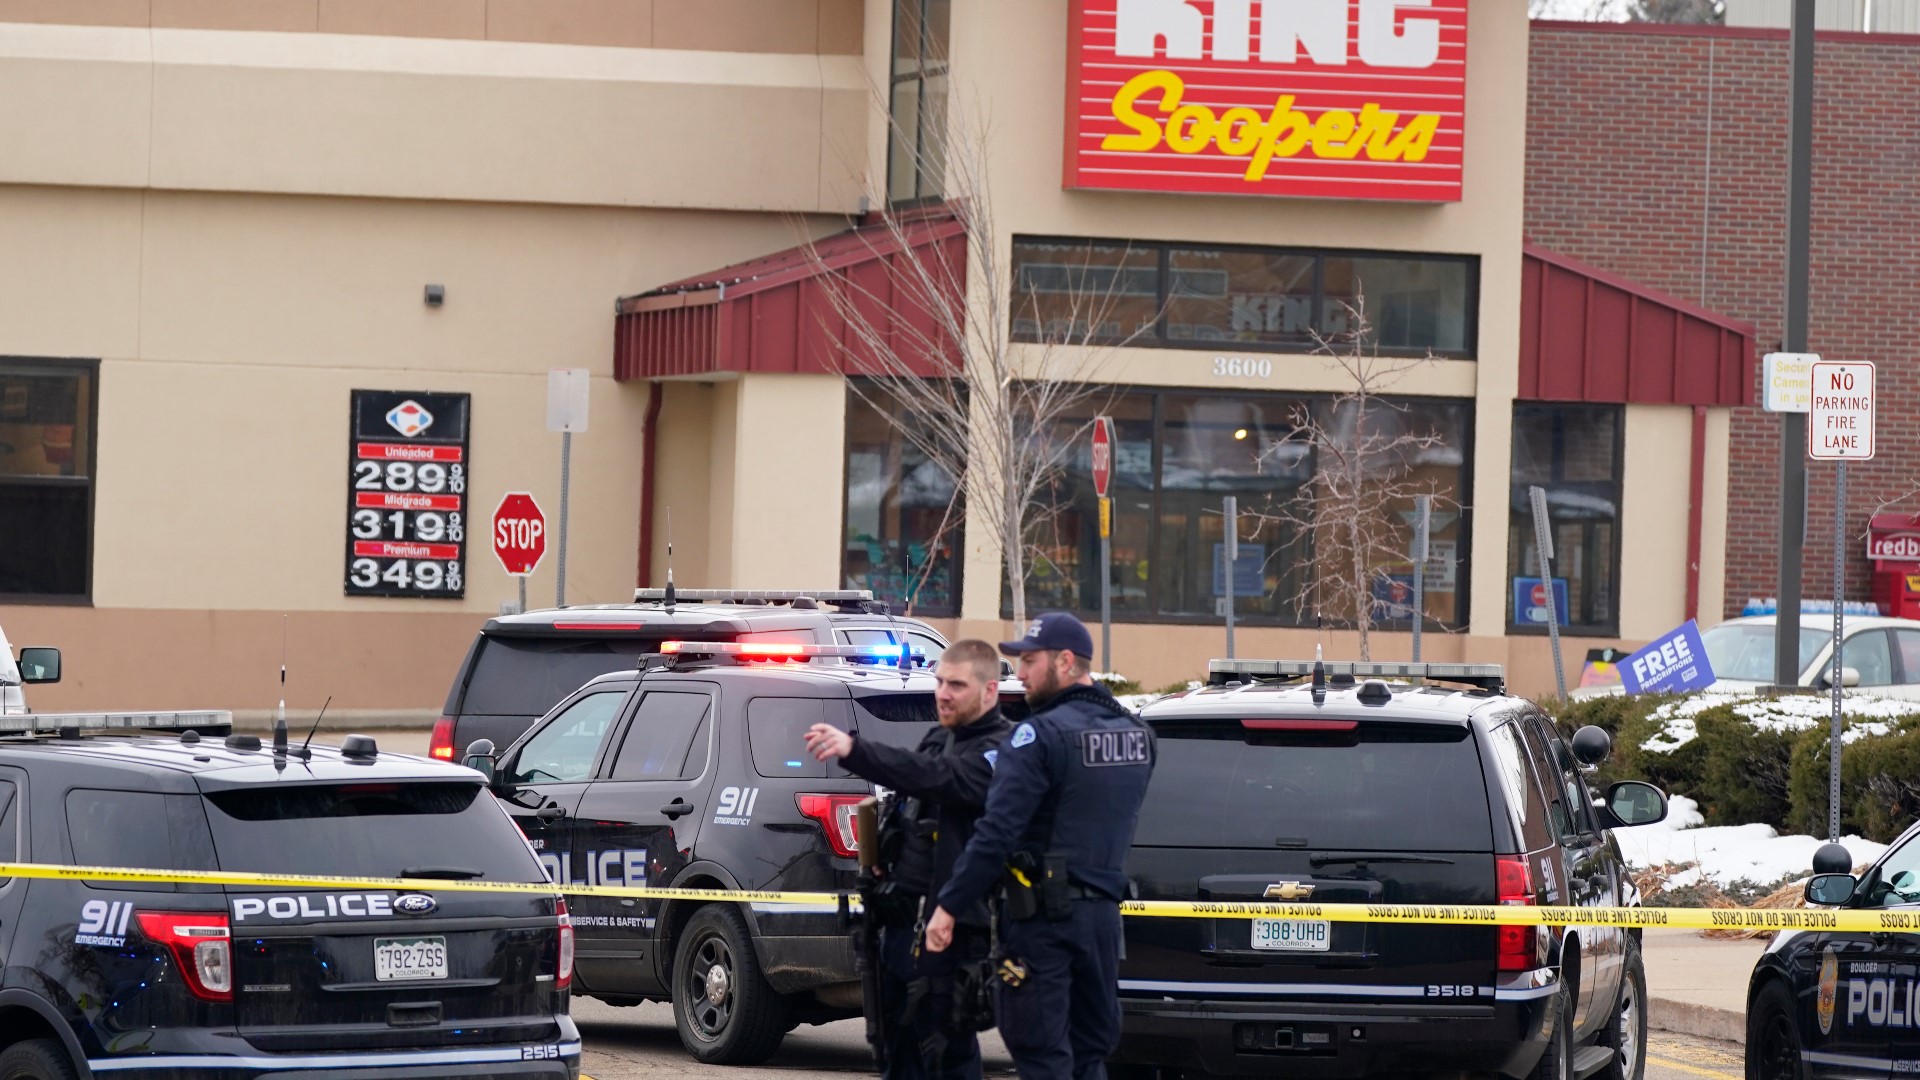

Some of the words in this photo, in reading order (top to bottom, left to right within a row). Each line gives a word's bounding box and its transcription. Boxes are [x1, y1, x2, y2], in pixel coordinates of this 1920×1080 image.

[1115, 0, 1440, 68] KING
[1101, 70, 1441, 181] Soopers
[1213, 356, 1272, 378] 3600
[1776, 361, 1810, 373] Securi
[1773, 376, 1810, 388] Camer
[1831, 373, 1854, 390] NO
[1816, 396, 1869, 410] PARKING
[1827, 415, 1857, 429] FIRE
[1825, 435, 1858, 448] LANE
[385, 447, 434, 459] Unleaded
[1094, 442, 1108, 471] STOP
[355, 460, 446, 492] 289
[384, 495, 432, 509] Midgrade
[352, 509, 445, 541] 319
[496, 517, 543, 550] STOP
[383, 544, 430, 557] Premium
[1875, 537, 1920, 556] redb
[350, 558, 443, 590] 349
[1632, 633, 1691, 683] FREE
[1089, 732, 1145, 763] POLICE
[716, 786, 759, 817] 911
[714, 816, 750, 826] EMERGENCY
[538, 849, 647, 888] OLICE
[233, 894, 394, 921] POLICE
[404, 897, 428, 910] Ford
[79, 900, 133, 935] 911
[1367, 905, 1399, 918] CROSS
[1402, 905, 1421, 918] NOT
[1424, 906, 1437, 919] DO
[1439, 907, 1461, 920] LINE
[1463, 907, 1496, 921] POLICE
[1540, 907, 1572, 921] CROSS
[1575, 908, 1593, 922] NOT
[1596, 909, 1609, 923] DO
[1611, 909, 1632, 923] LINE
[1634, 910, 1667, 925] POLICE
[1711, 911, 1743, 926] CROSS
[1745, 911, 1763, 926] NOT
[1766, 911, 1779, 926] DO
[576, 917, 608, 926] SERVICE
[609, 917, 615, 926] &
[616, 917, 647, 927] SAFETY
[1781, 912, 1802, 927] LINE
[1804, 912, 1837, 927] POLICE
[1880, 913, 1910, 928] CROSS
[75, 934, 126, 947] EMERGENCY
[1850, 963, 1878, 973] BOULDER
[1427, 985, 1475, 997] 3518
[1848, 978, 1920, 1028] POLI
[523, 1045, 559, 1060] 2515
